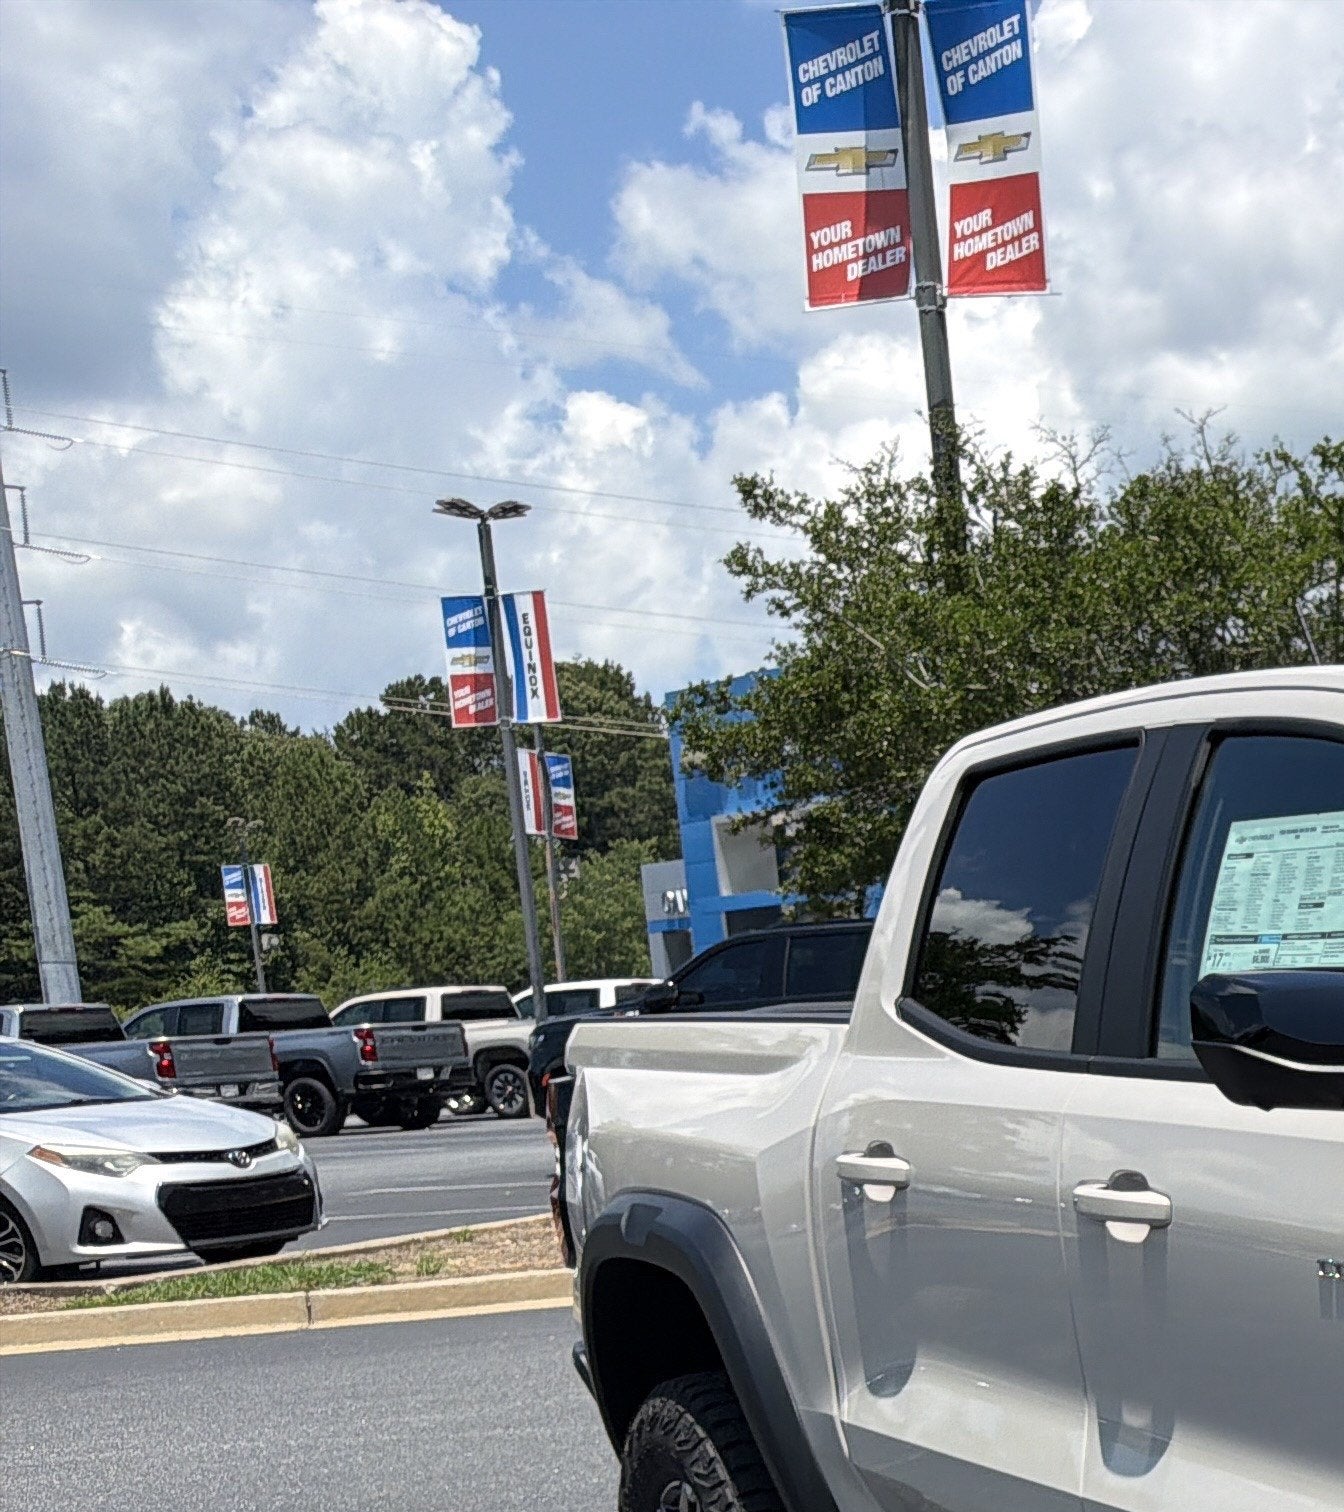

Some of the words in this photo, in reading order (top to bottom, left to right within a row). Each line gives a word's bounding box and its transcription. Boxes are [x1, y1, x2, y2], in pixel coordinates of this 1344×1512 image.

[798, 30, 880, 83] CHEVROLET
[942, 14, 1021, 71] CHEVROLET
[946, 75, 965, 96] OF
[968, 39, 1022, 85] CANTON
[802, 86, 821, 107] OF
[825, 57, 884, 98] CANTON
[810, 220, 852, 249] YOUR
[812, 225, 901, 272] HOMETOWN
[953, 210, 1034, 261] HOMETOWN
[954, 209, 992, 238] YOUR
[846, 247, 906, 281] DEALER
[985, 233, 1039, 271] DEALER
[521, 612, 540, 700] EQUINOX
